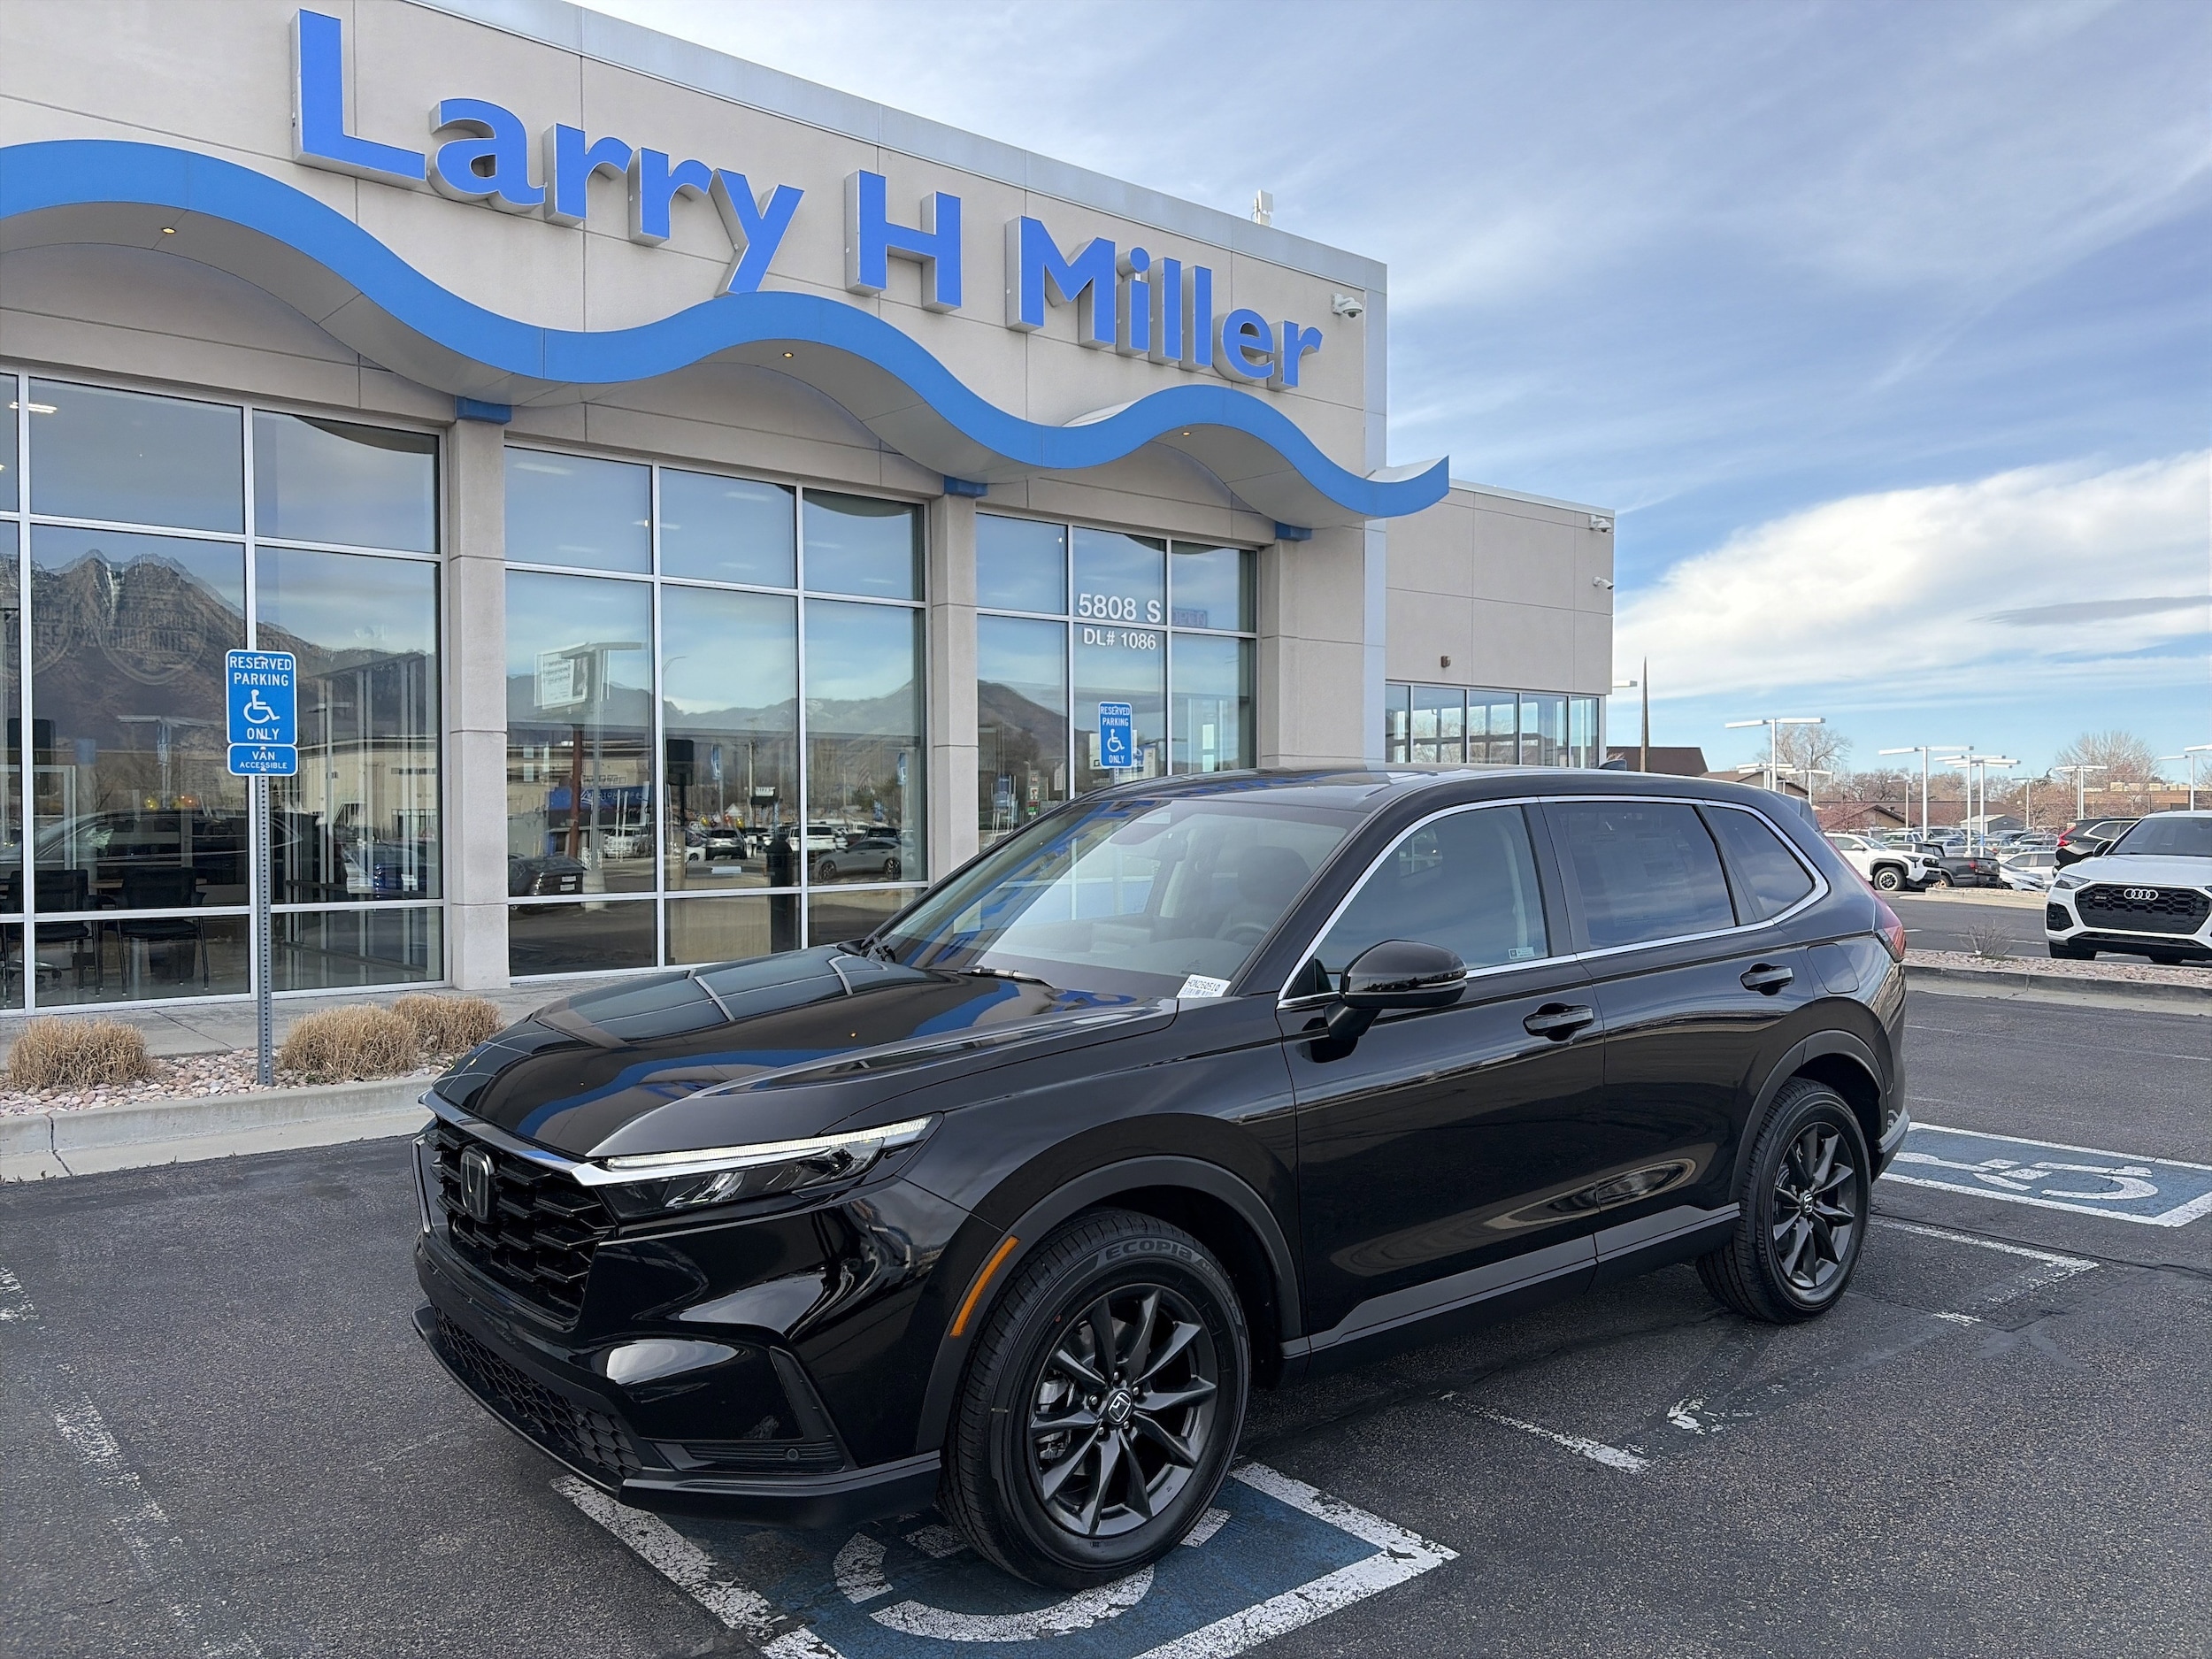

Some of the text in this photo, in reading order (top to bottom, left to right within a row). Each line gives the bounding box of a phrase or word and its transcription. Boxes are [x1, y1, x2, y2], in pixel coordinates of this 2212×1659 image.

[295, 8, 1324, 389] Larry H Miller
[1078, 593, 1162, 624] 5808 S
[1083, 627, 1156, 650] DL# 1086
[229, 656, 292, 671] RESERVED
[234, 672, 289, 687] PARKING
[1100, 705, 1130, 716] RESERVED
[1102, 717, 1129, 727] PARKING
[246, 727, 280, 741] ONLY
[251, 750, 275, 761] VAN
[1108, 754, 1125, 764] ONLY
[239, 761, 288, 770] ACCESSIBLE
